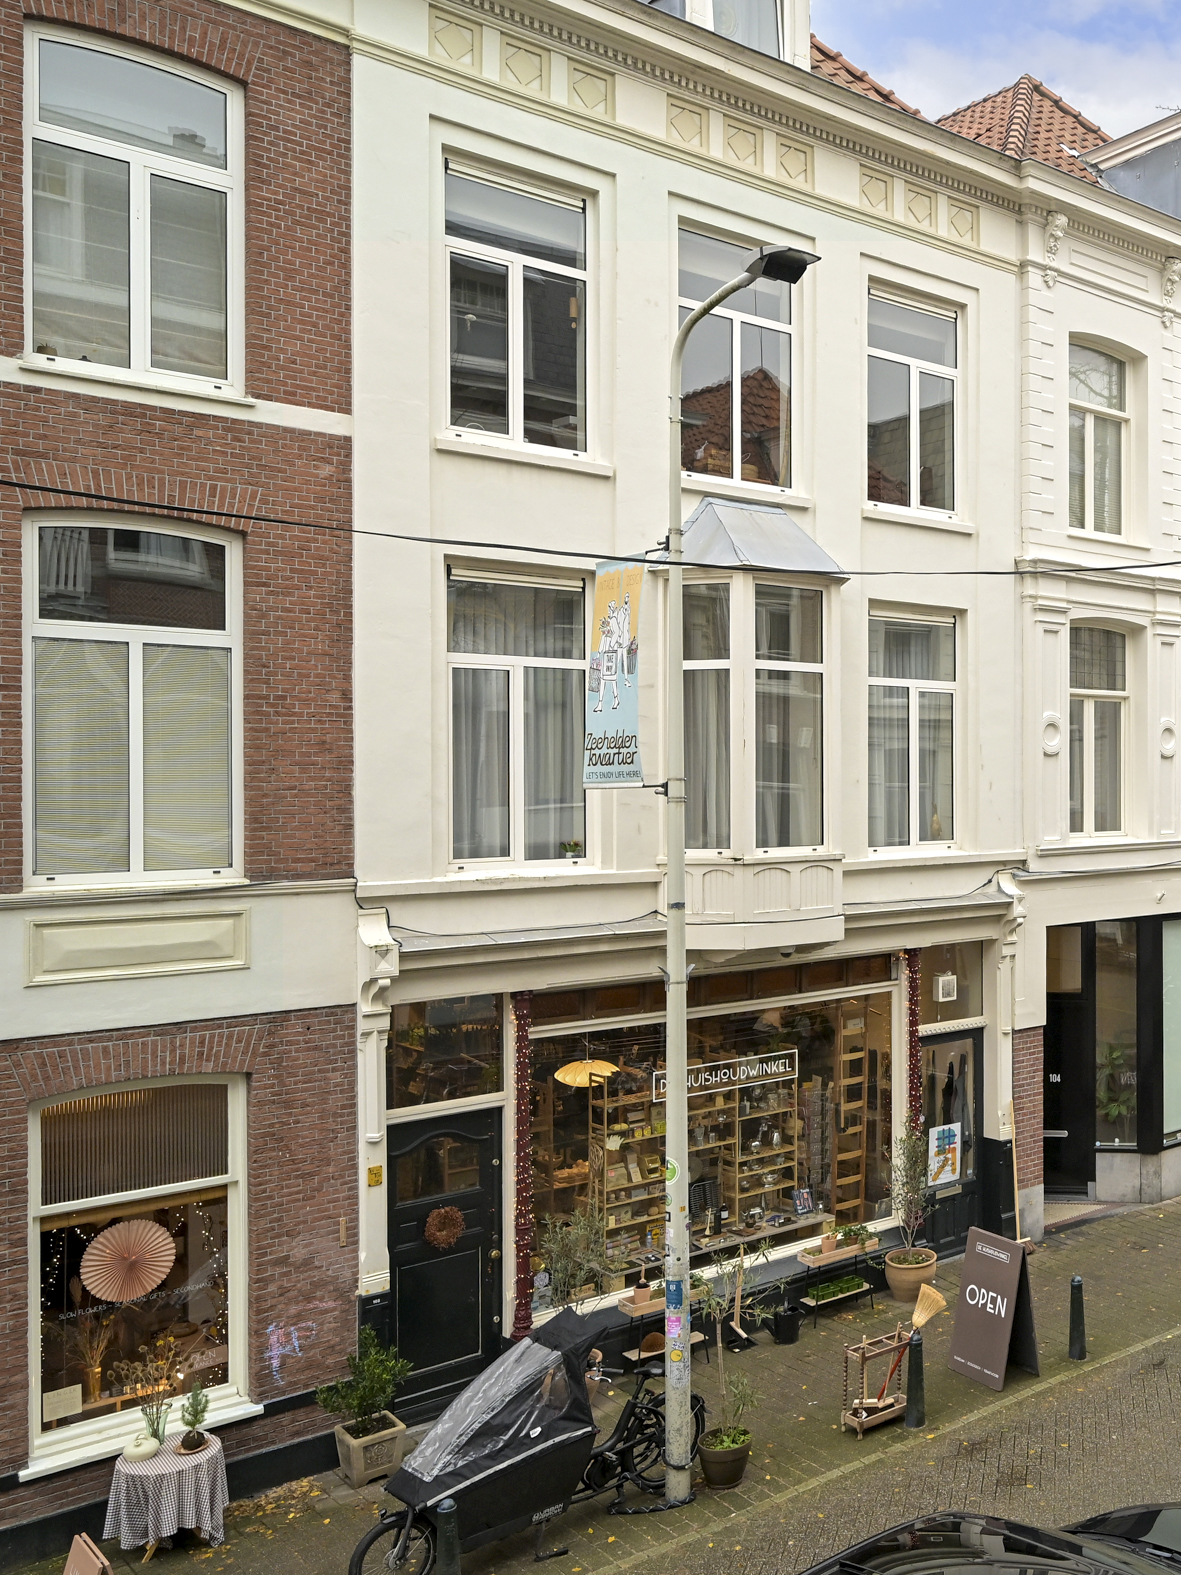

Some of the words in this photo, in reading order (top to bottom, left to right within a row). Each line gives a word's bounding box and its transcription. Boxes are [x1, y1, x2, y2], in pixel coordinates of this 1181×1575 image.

[585, 729, 638, 750] Zeehelden
[587, 749, 638, 767] kwartier
[586, 771, 599, 779] LET'S
[600, 770, 614, 779] ENJOY
[614, 770, 626, 779] LIFE
[626, 770, 641, 778] HERE!
[1049, 1073, 1061, 1083] 104
[58, 1310, 77, 1320] SLOW
[77, 1303, 107, 1316] FLOWERS
[114, 1296, 148, 1308] SEASONAL
[149, 1290, 166, 1300] GIFTS
[173, 1280, 214, 1295] SECONDHAND
[965, 1284, 1007, 1318] OPEN
